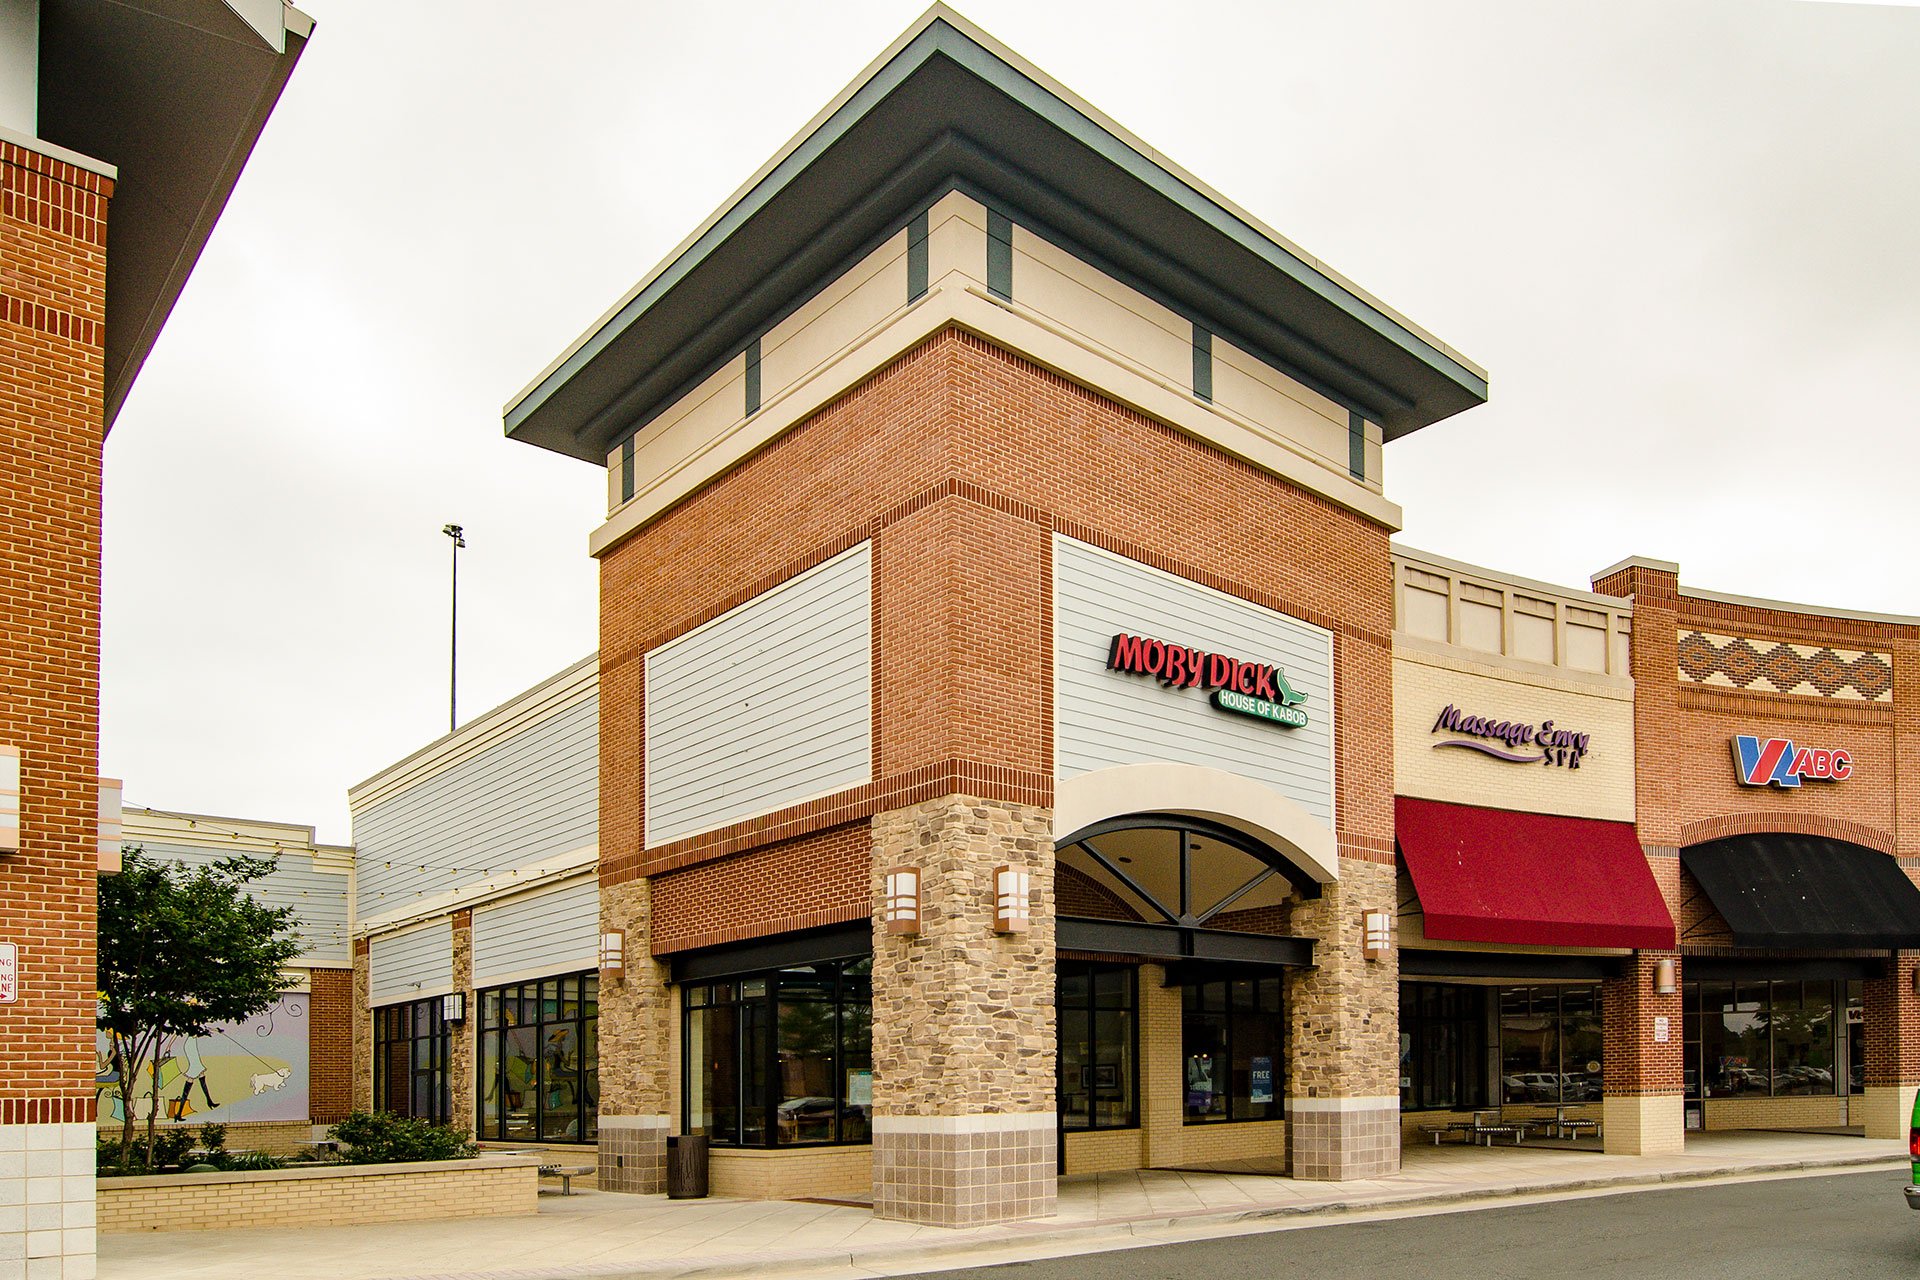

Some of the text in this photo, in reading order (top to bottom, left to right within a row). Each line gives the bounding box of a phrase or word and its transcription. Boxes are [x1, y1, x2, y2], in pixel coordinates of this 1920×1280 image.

[1108, 633, 1275, 699] MOBY DICK
[1221, 690, 1307, 726] HOUSE OF KABOB
[1432, 704, 1590, 756] Massage Envy
[1544, 747, 1580, 769] SPA
[1787, 748, 1852, 780] ABC
[1252, 1070, 1270, 1079] FREE
